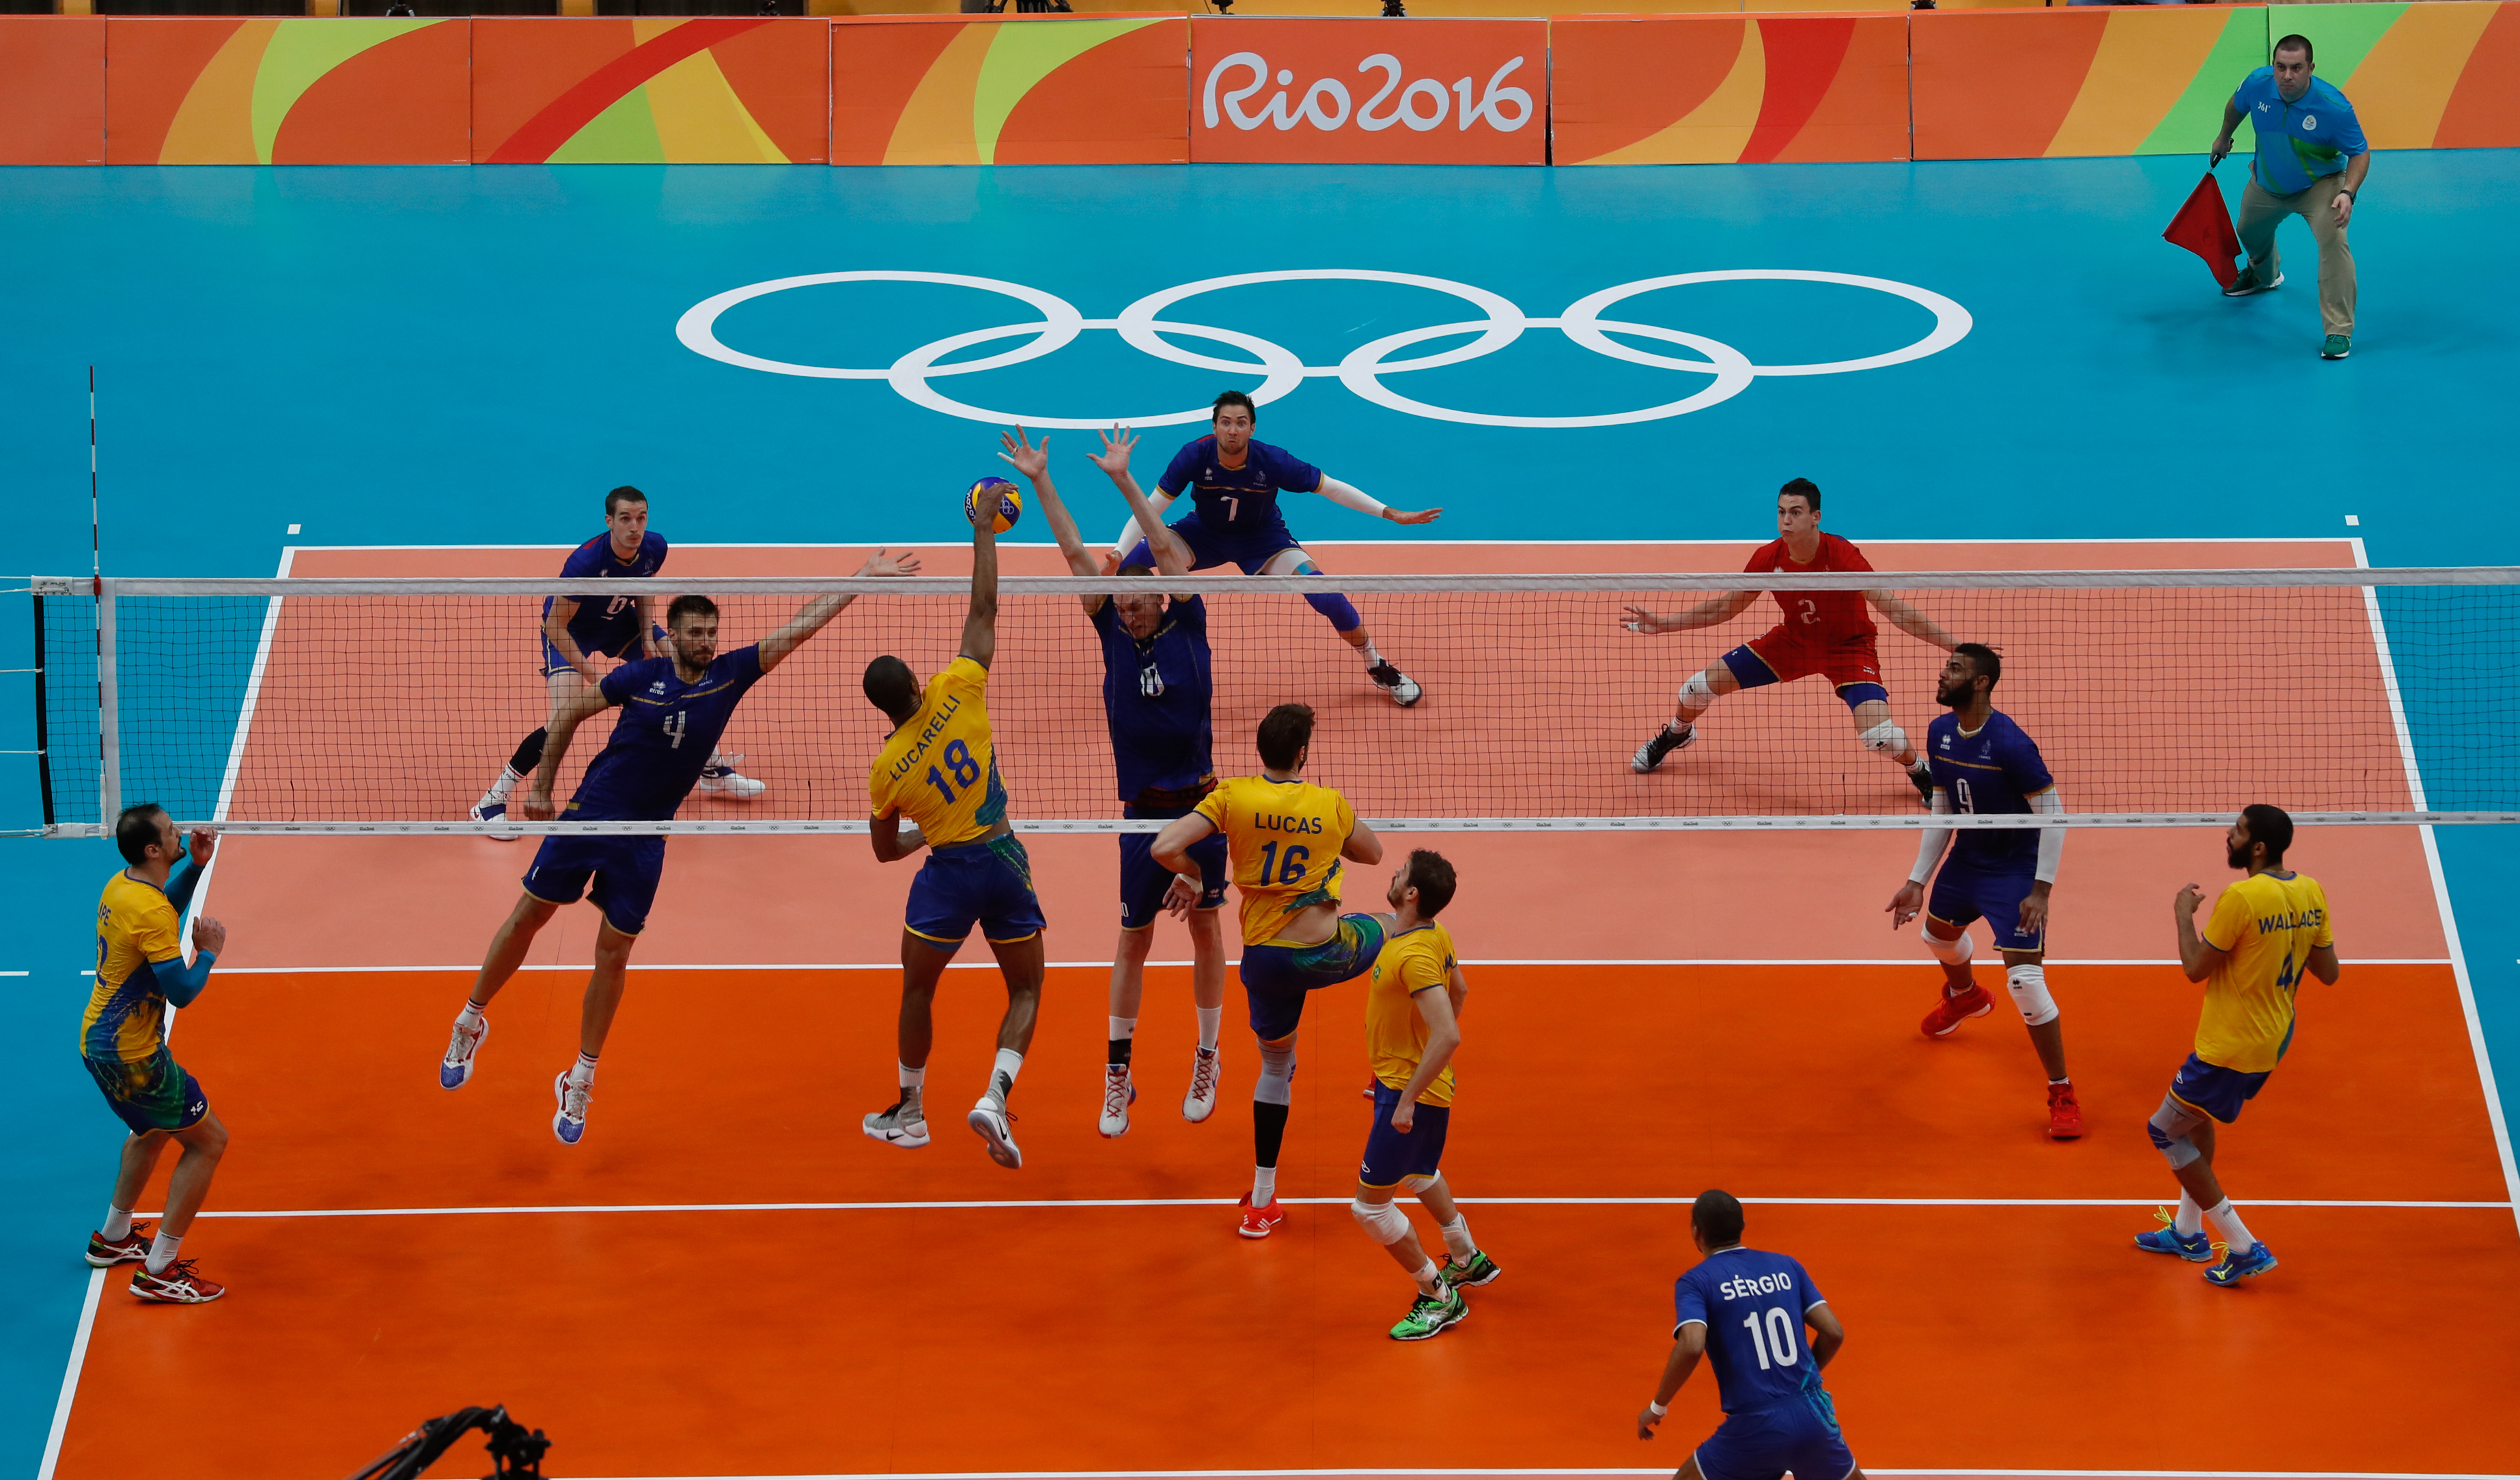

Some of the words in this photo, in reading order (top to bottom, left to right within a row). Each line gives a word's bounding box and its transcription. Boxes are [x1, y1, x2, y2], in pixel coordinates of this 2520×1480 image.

[1220, 495, 1238, 522] 7
[1797, 599, 1821, 624] 2
[663, 711, 686, 749] 4
[889, 695, 961, 781] LUCARELLI
[925, 739, 981, 805] 18
[1957, 778, 1974, 814] 9
[1255, 812, 1322, 835] LUCAS
[1261, 840, 1310, 887] 16
[97, 902, 111, 926] IPE
[2258, 909, 2323, 935] WALLACE
[2276, 951, 2294, 992] 4
[1720, 1272, 1792, 1301] SÉRGIO
[1743, 1307, 1798, 1371] 10
